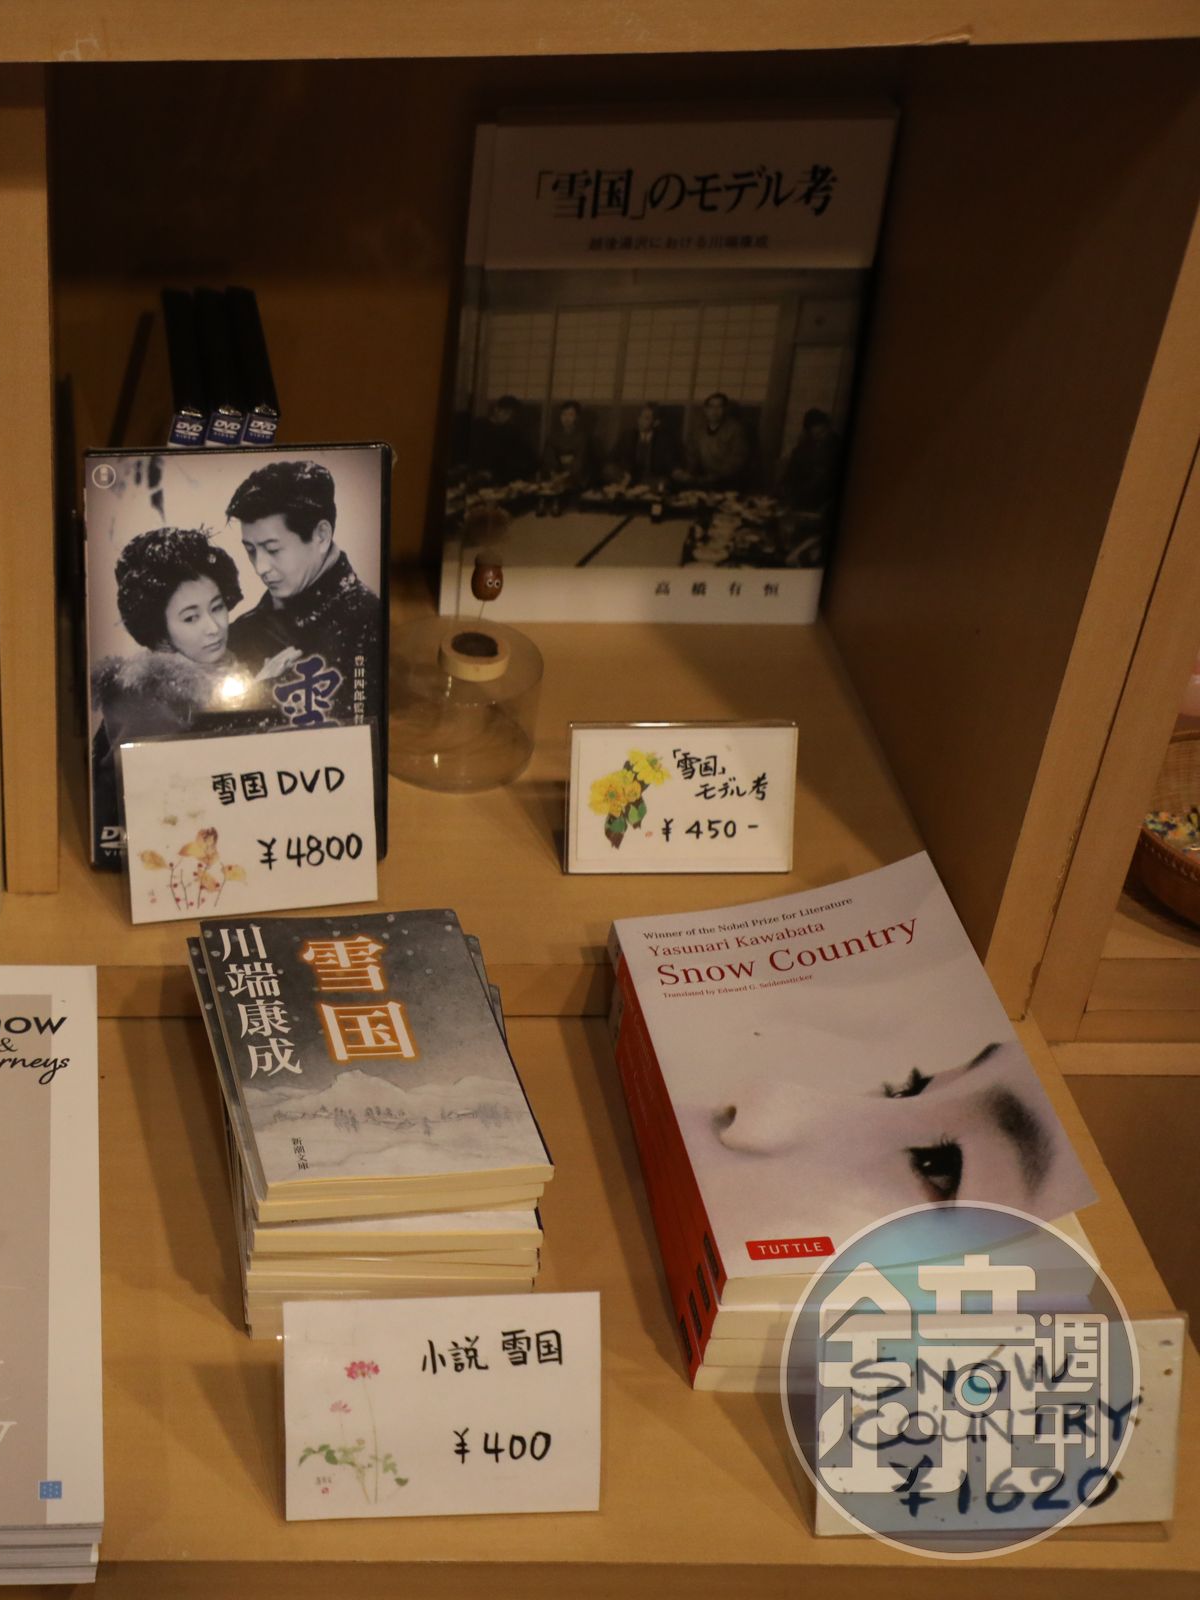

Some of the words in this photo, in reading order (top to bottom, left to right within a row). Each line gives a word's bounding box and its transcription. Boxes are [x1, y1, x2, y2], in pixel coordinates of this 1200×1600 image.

[536, 164, 837, 220] 「雪国」のモデル考
[176, 421, 203, 432] DVD
[214, 419, 241, 430] DVD
[250, 420, 277, 431] DVD
[672, 748, 727, 780] 「雪国」
[694, 772, 769, 801] モデル考
[257, 833, 363, 871] ¥4800
[643, 929, 683, 940] Winner
[685, 927, 697, 937] of
[698, 926, 716, 936] the
[718, 921, 750, 933] Nobel
[752, 915, 780, 928] Prize
[781, 912, 797, 922] for
[799, 897, 853, 918] Literature
[648, 938, 731, 958] Yasunari
[735, 922, 826, 949] Kawabata
[657, 960, 756, 986] Snow
[768, 917, 918, 972] Country
[217, 924, 304, 1079] 川端康成
[301, 934, 420, 1063] 雪国
[663, 988, 705, 999] Translated
[717, 984, 748, 995] Edward
[757, 1240, 825, 1257] TUTTLE
[420, 1335, 490, 1375] 小説
[500, 1329, 565, 1367] 雪国
[848, 1351, 1075, 1400] SNOW
[847, 1394, 1144, 1452] COUNTRY
[453, 1427, 553, 1466] ¥400
[888, 1454, 1121, 1518] ¥1620
